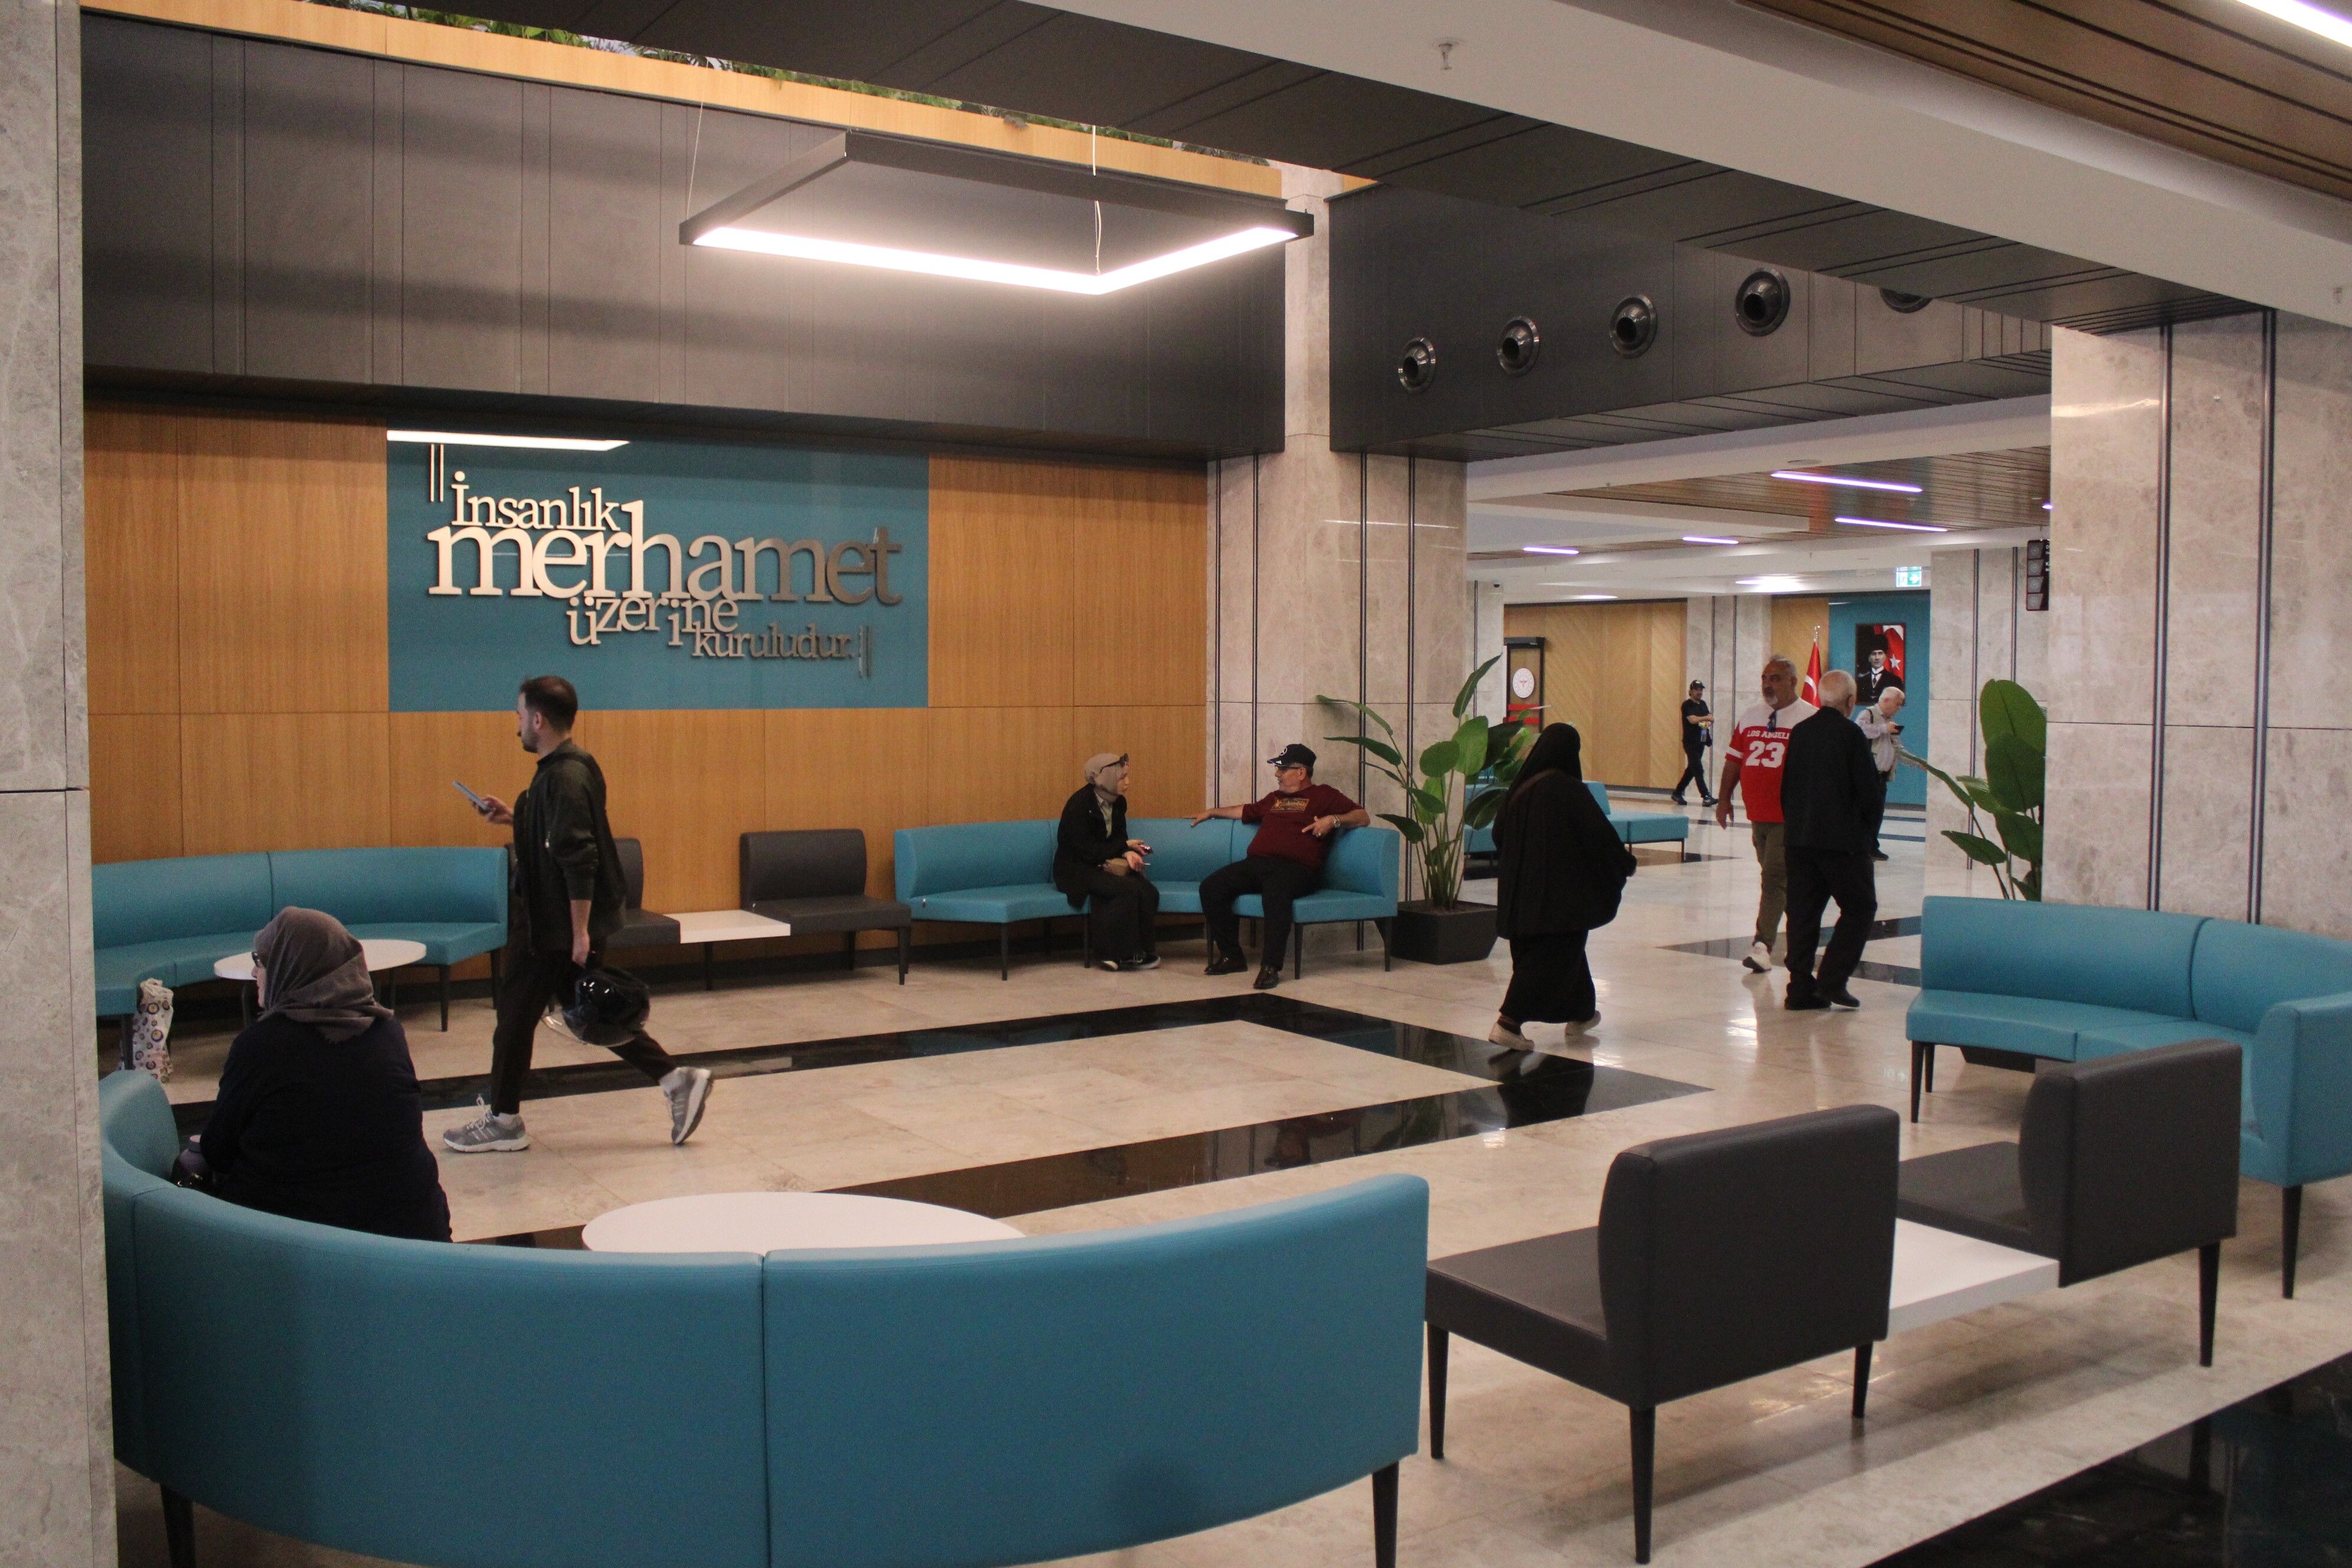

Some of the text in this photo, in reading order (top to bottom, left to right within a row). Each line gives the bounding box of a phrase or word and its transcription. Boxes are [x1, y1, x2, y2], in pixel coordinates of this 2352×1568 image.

[427, 499, 903, 605] merhamet
[566, 596, 739, 646] üzerine
[1745, 740, 1786, 768] 23
